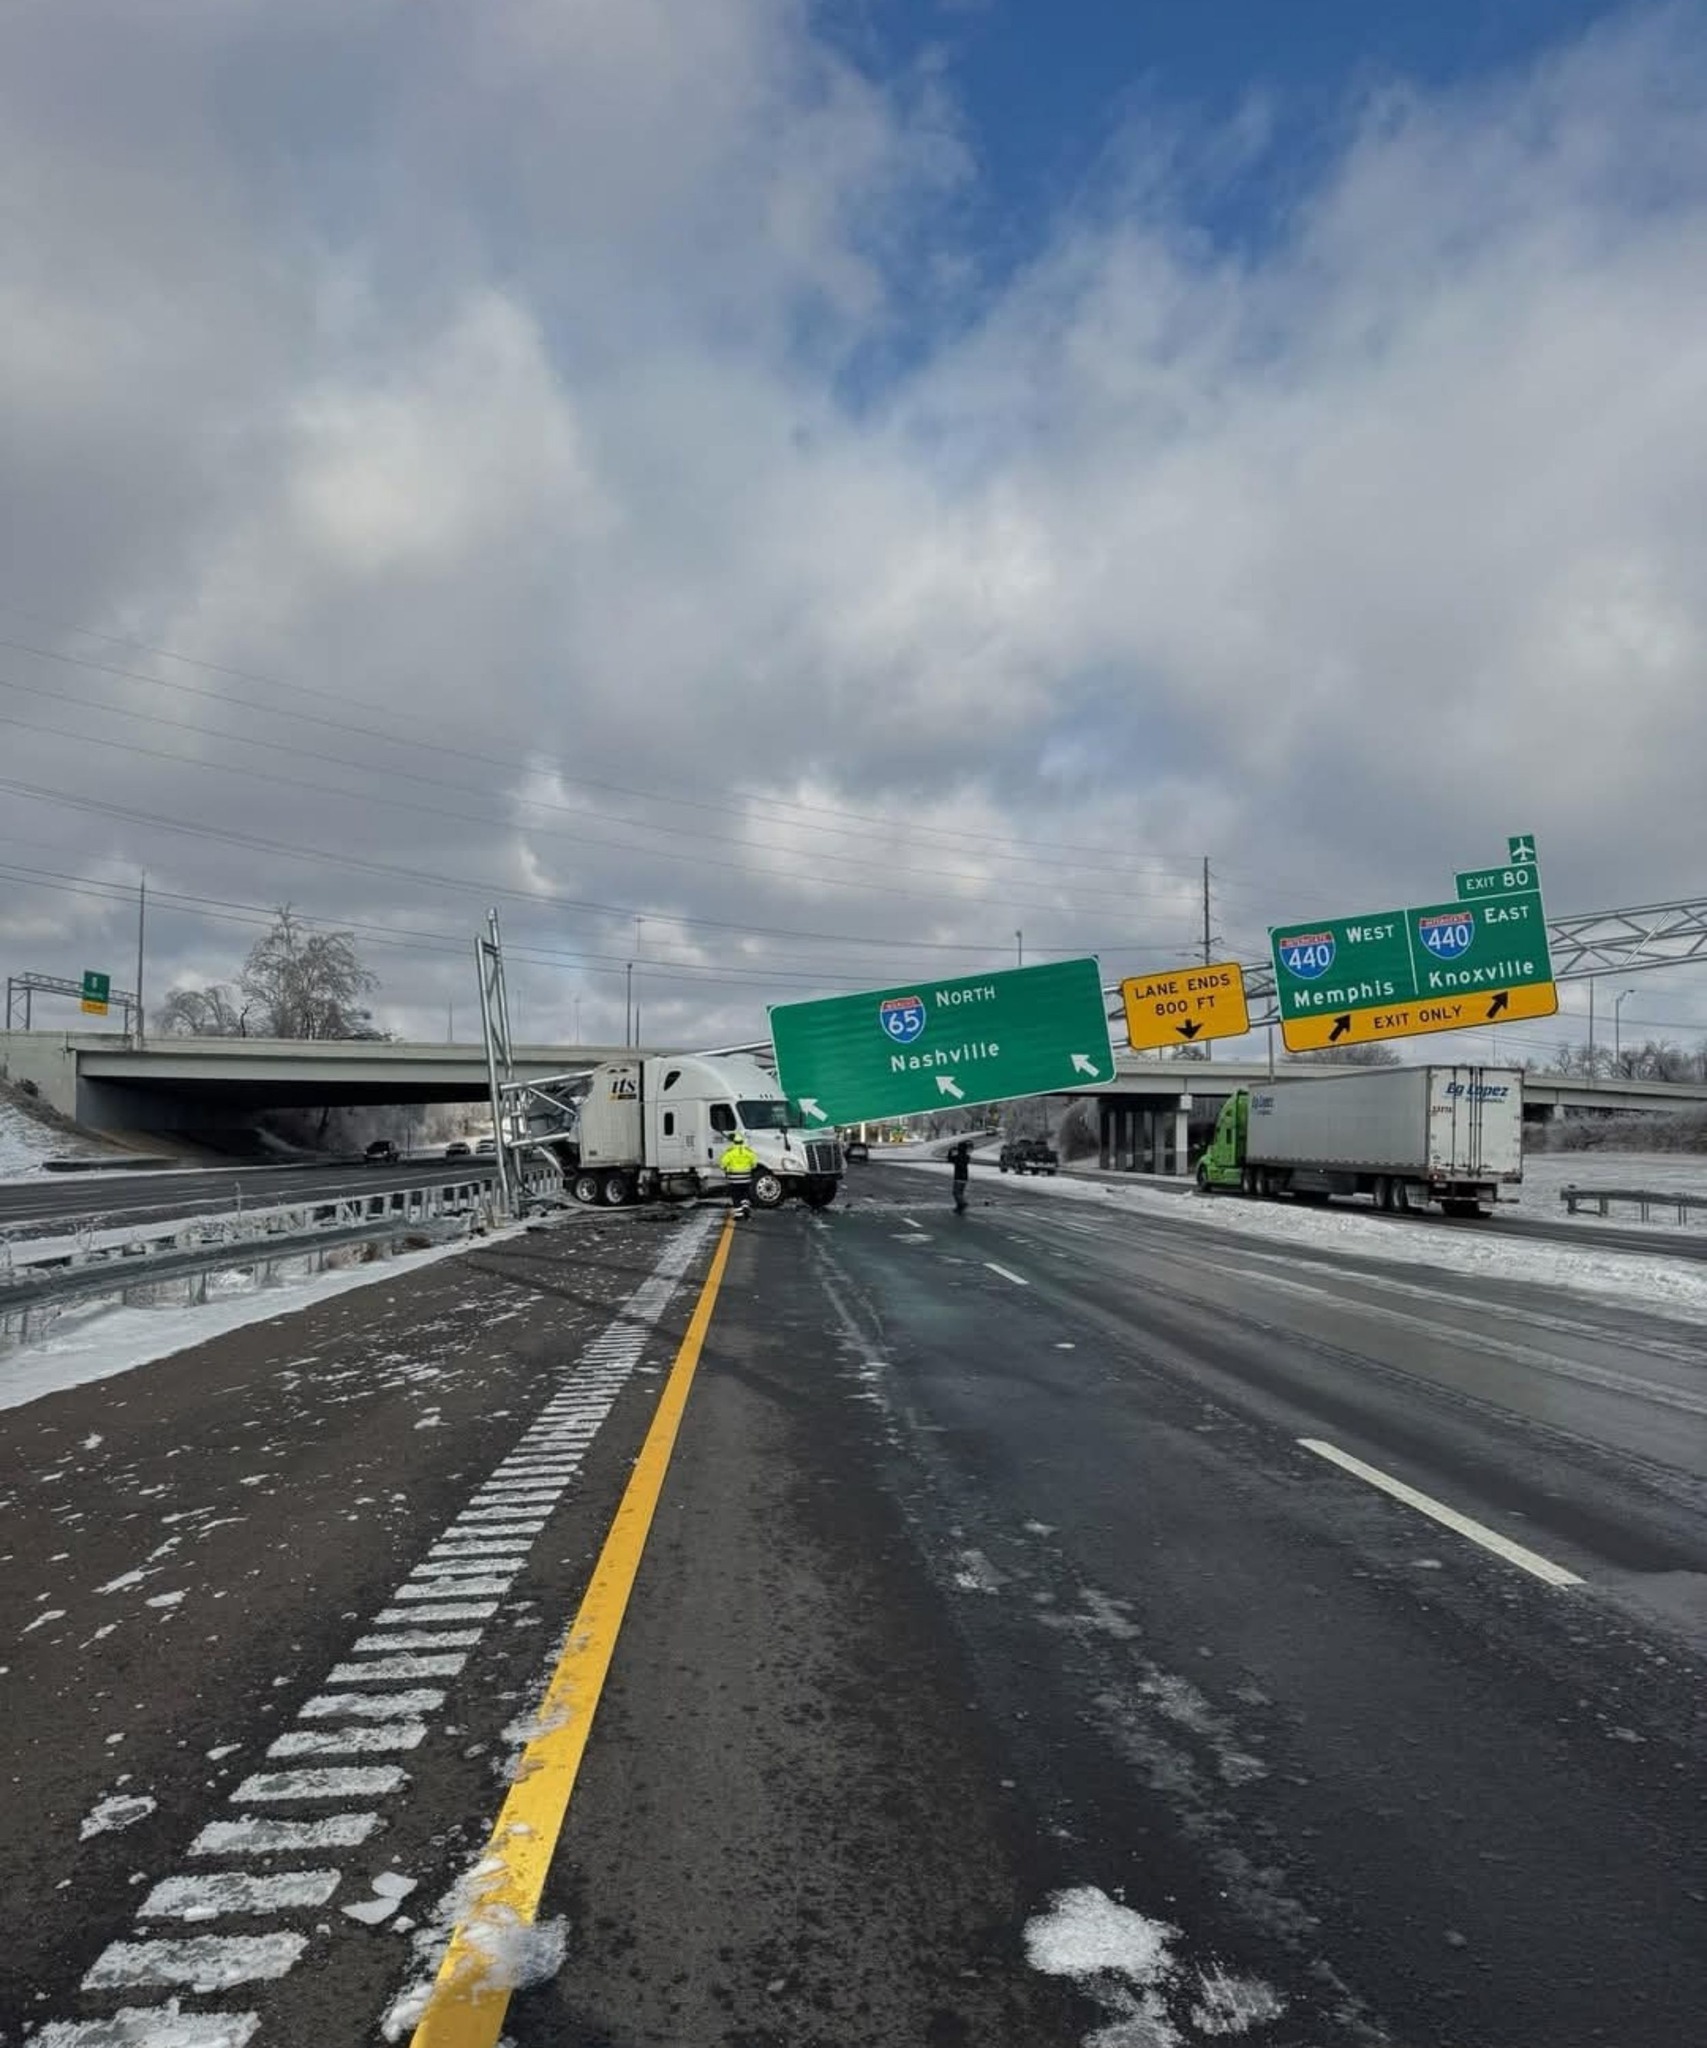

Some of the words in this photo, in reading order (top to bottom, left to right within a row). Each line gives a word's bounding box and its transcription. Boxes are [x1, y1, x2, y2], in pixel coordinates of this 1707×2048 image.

[1465, 876, 1495, 891] EXIT
[1502, 870, 1529, 888] 80
[1484, 906, 1529, 924] EAST
[1346, 925, 1394, 944] WEST
[1428, 924, 1469, 950] 440
[1288, 945, 1330, 970] 440
[1134, 982, 1179, 1000] LANE
[1187, 972, 1231, 992] ENDS
[1428, 960, 1535, 989] Knoxville
[935, 985, 996, 1007] NORTH
[1154, 997, 1188, 1016] 800
[1196, 995, 1217, 1011] FT
[1293, 980, 1395, 1008] Memphis
[888, 1009, 921, 1035] 65
[1373, 1012, 1410, 1029] EXIT
[1419, 1004, 1463, 1022] ONLY
[890, 1041, 1000, 1073] Nashville
